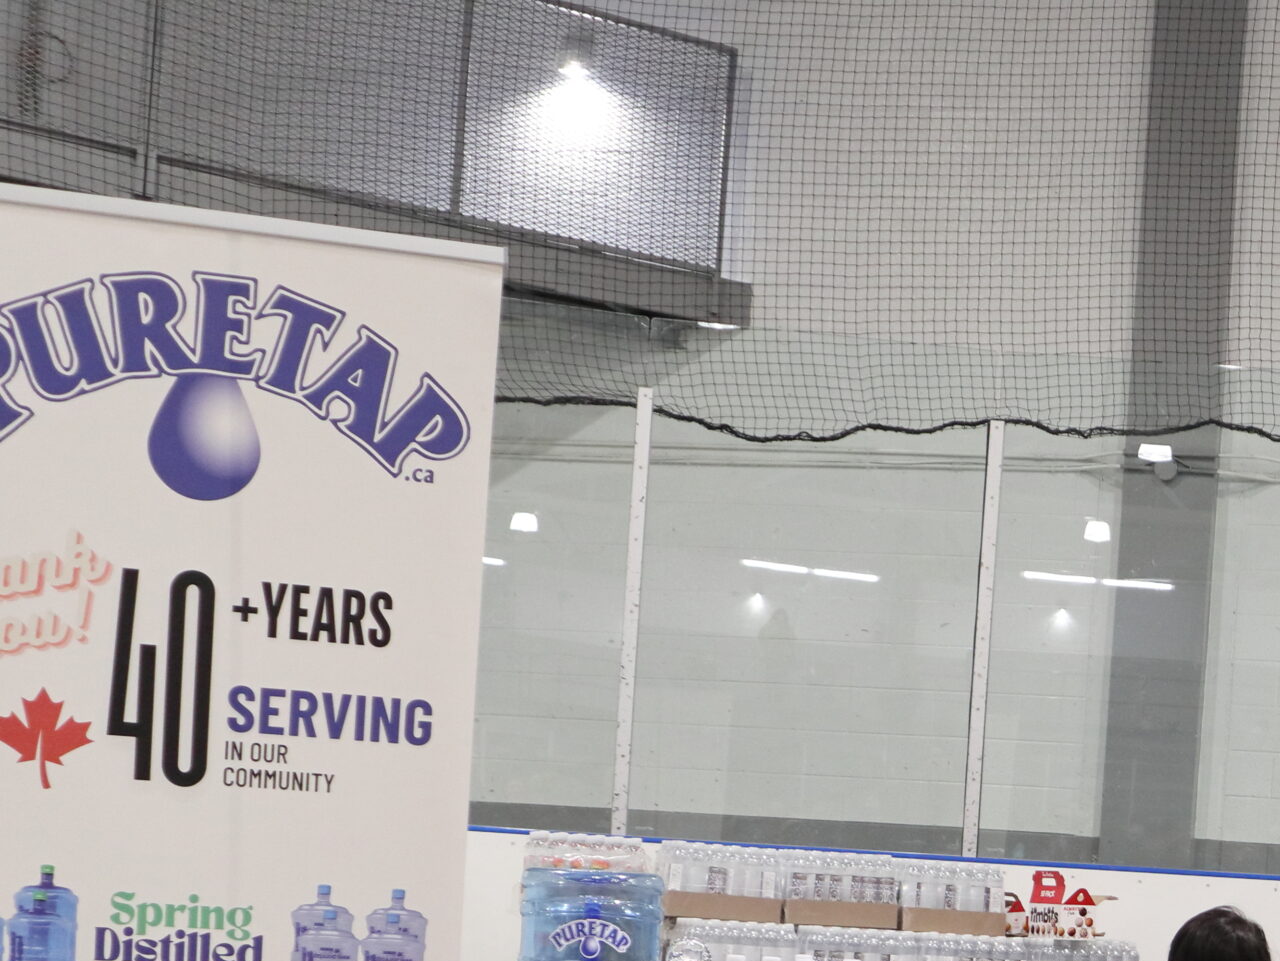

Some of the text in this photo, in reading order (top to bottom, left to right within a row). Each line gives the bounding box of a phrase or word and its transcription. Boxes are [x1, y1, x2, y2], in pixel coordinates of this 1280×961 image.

[404, 466, 435, 484] .ca
[232, 581, 393, 649] +YEARS
[107, 567, 216, 788] 40
[226, 684, 434, 747] SERVING
[224, 741, 289, 765] IN OUR
[222, 766, 336, 794] COMMUNITY
[109, 890, 254, 941] Spring
[552, 919, 630, 950] PURETAP
